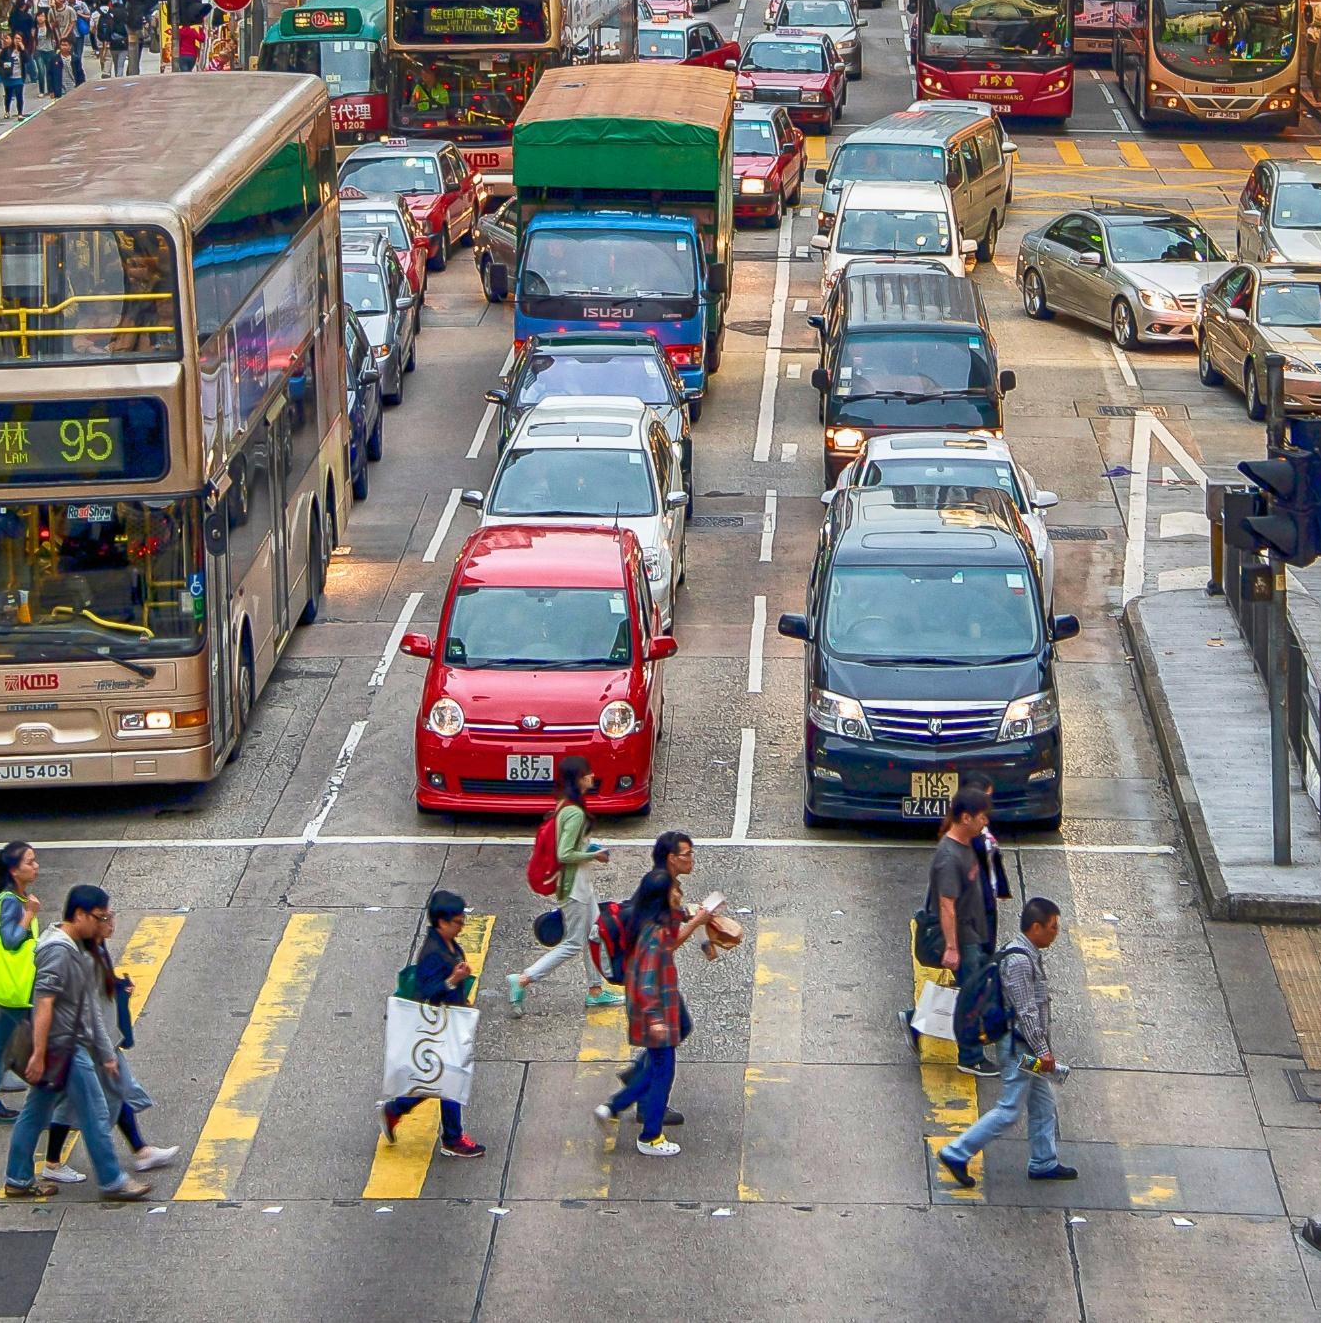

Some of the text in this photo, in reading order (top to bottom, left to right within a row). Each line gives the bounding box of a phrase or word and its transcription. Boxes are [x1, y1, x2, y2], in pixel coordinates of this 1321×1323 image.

[312, 13, 327, 26] 12A
[979, 93, 1002, 102] CHENG
[342, 121, 365, 130] 1202
[388, 138, 406, 146] TAXI
[464, 152, 500, 168] KMB
[583, 307, 634, 318] ISUZU
[59, 418, 113, 462] 95
[4, 452, 29, 464] LAM
[67, 504, 113, 519] RoadShow
[18, 673, 60, 692] KMB
[0, 764, 68, 778] JU 5403
[509, 768, 551, 780] 8073
[924, 773, 945, 786] KK
[919, 784, 950, 798] 1162
